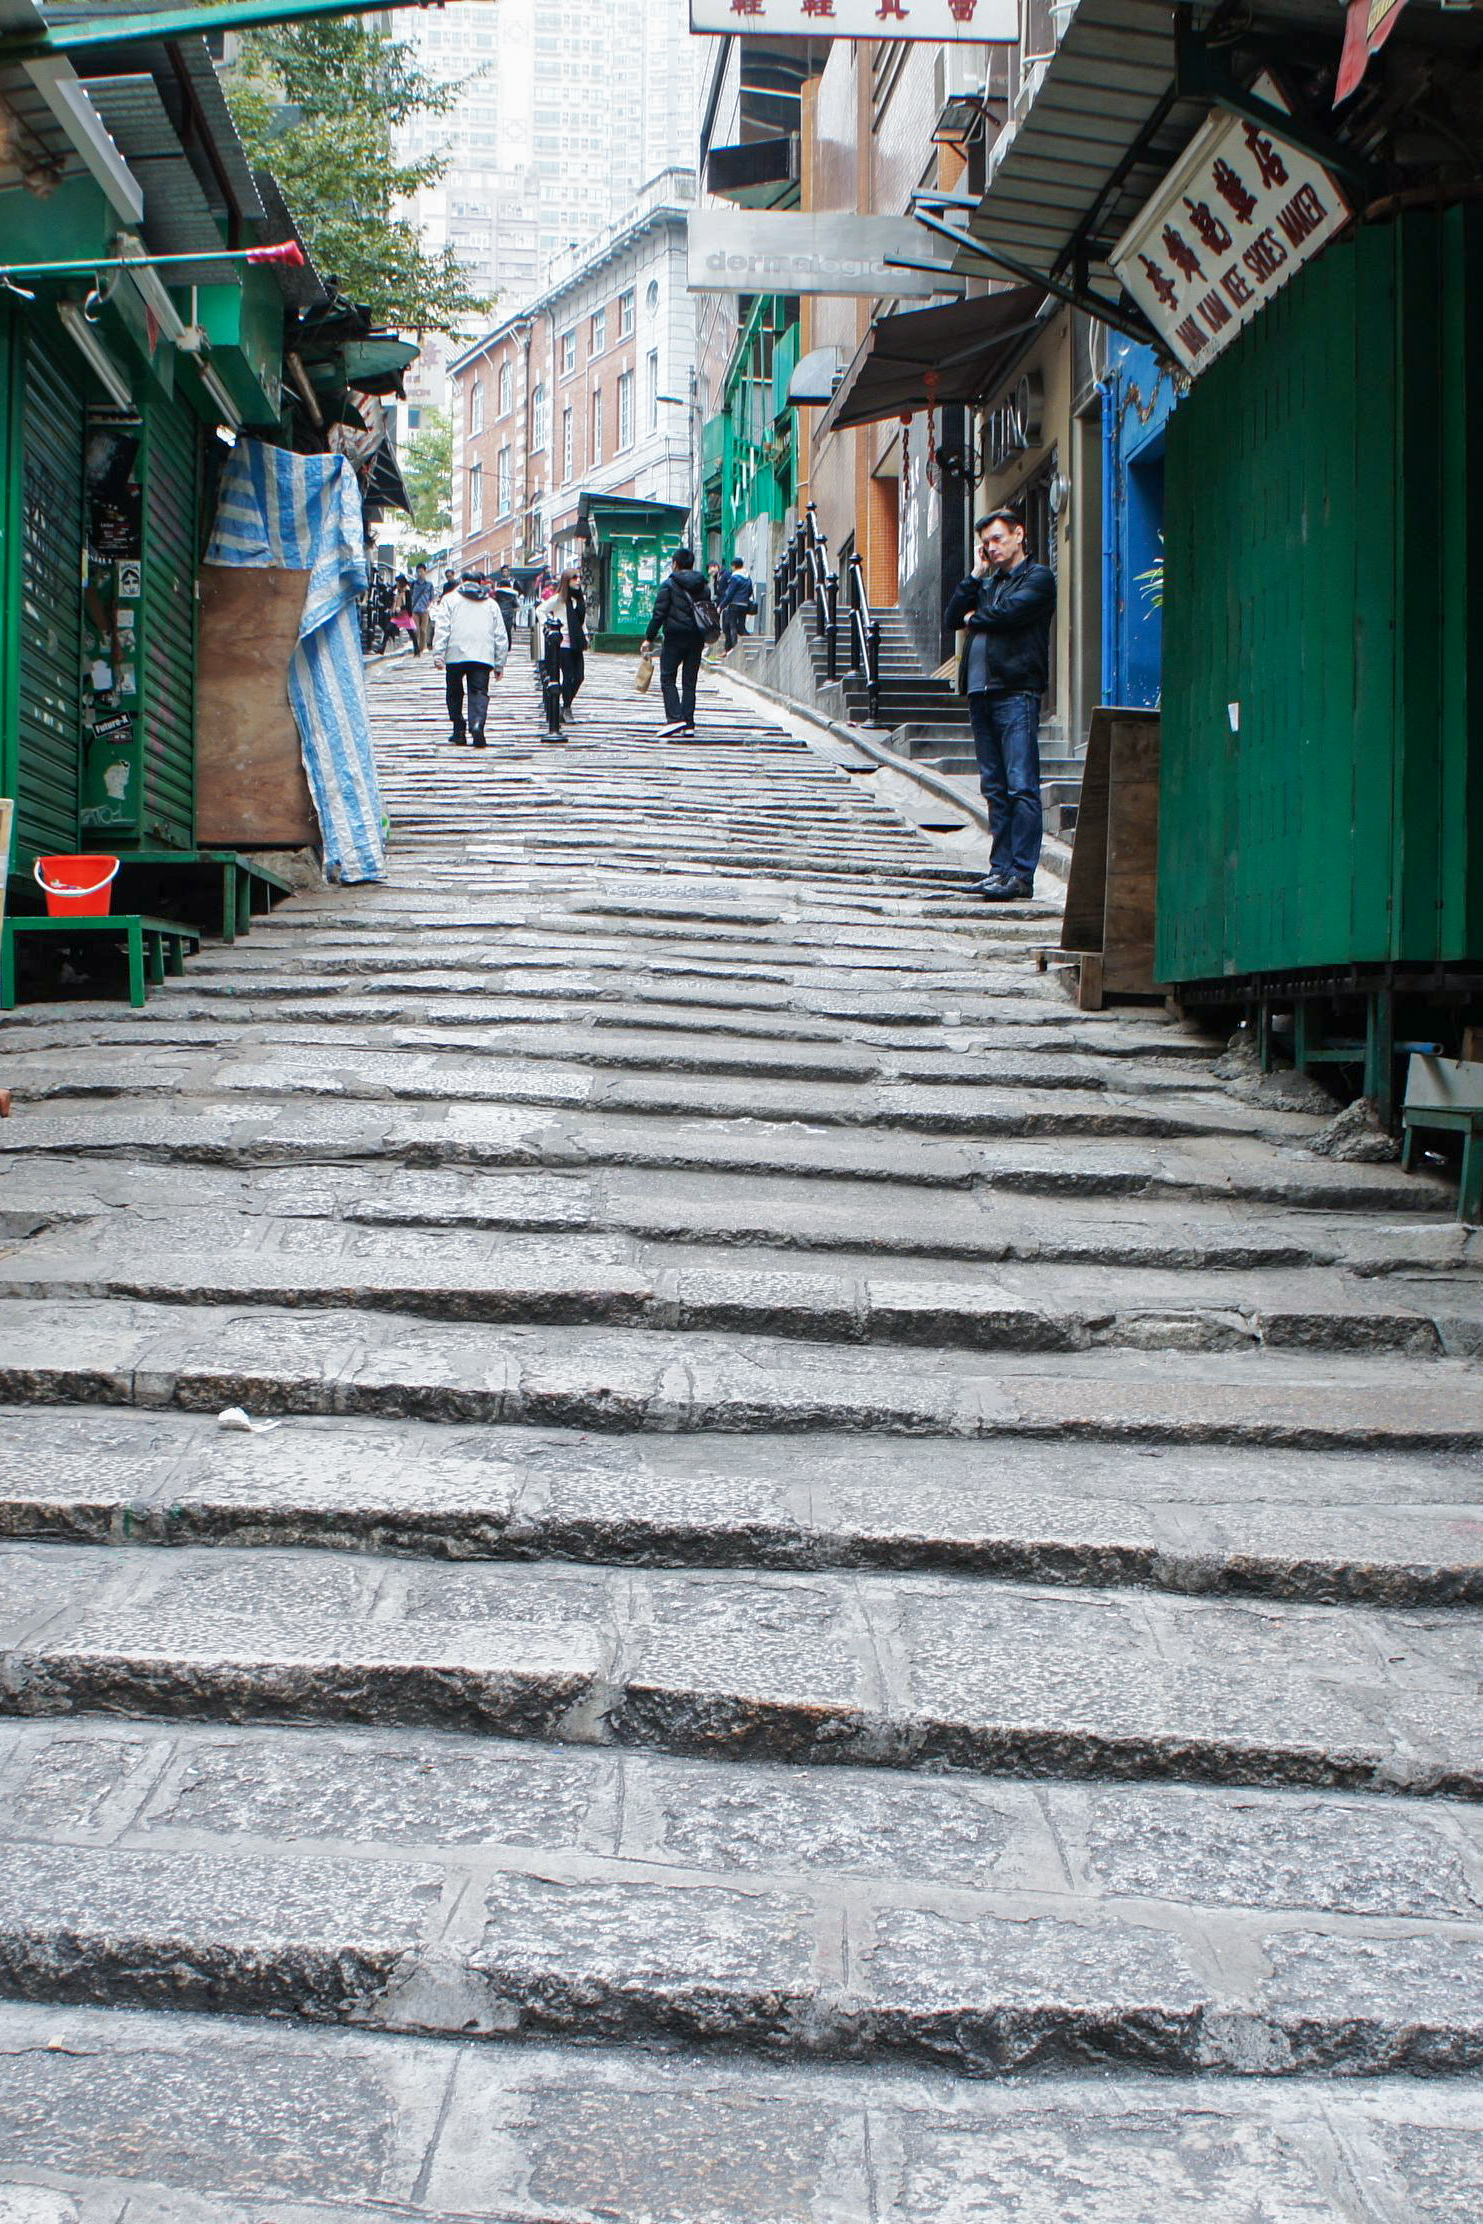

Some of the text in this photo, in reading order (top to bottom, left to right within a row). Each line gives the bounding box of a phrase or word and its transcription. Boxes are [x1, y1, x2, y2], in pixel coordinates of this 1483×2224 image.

[1220, 263, 1255, 309] KEE
[1242, 227, 1288, 285] SHOES
[1276, 182, 1329, 248] MAKER
